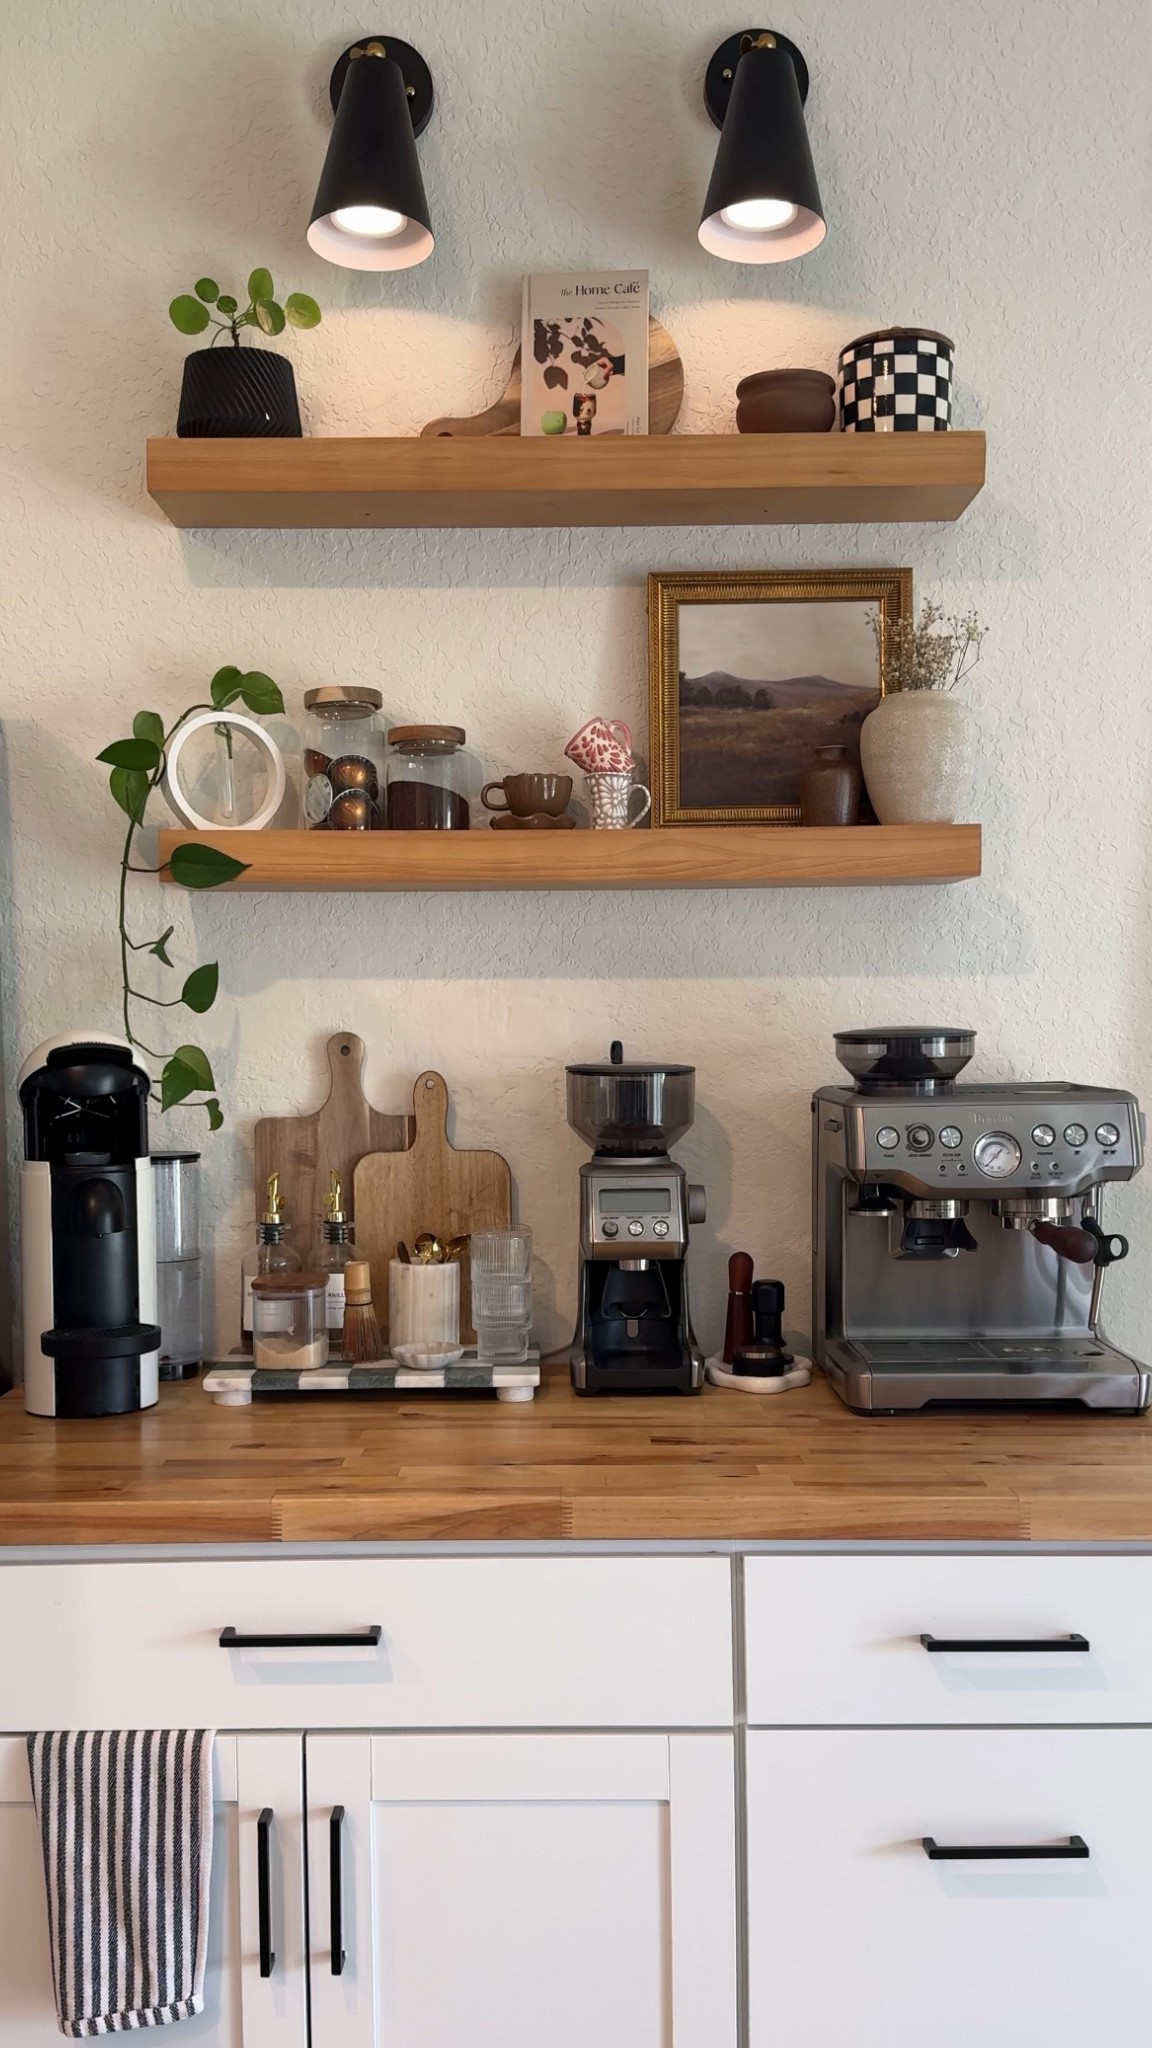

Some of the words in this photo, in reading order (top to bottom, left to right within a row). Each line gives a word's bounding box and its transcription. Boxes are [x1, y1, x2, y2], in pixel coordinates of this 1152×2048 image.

[561, 288, 573, 297] the
[575, 284, 611, 296] Home
[614, 281, 640, 295] Café
[973, 1112, 1016, 1124] Breville
